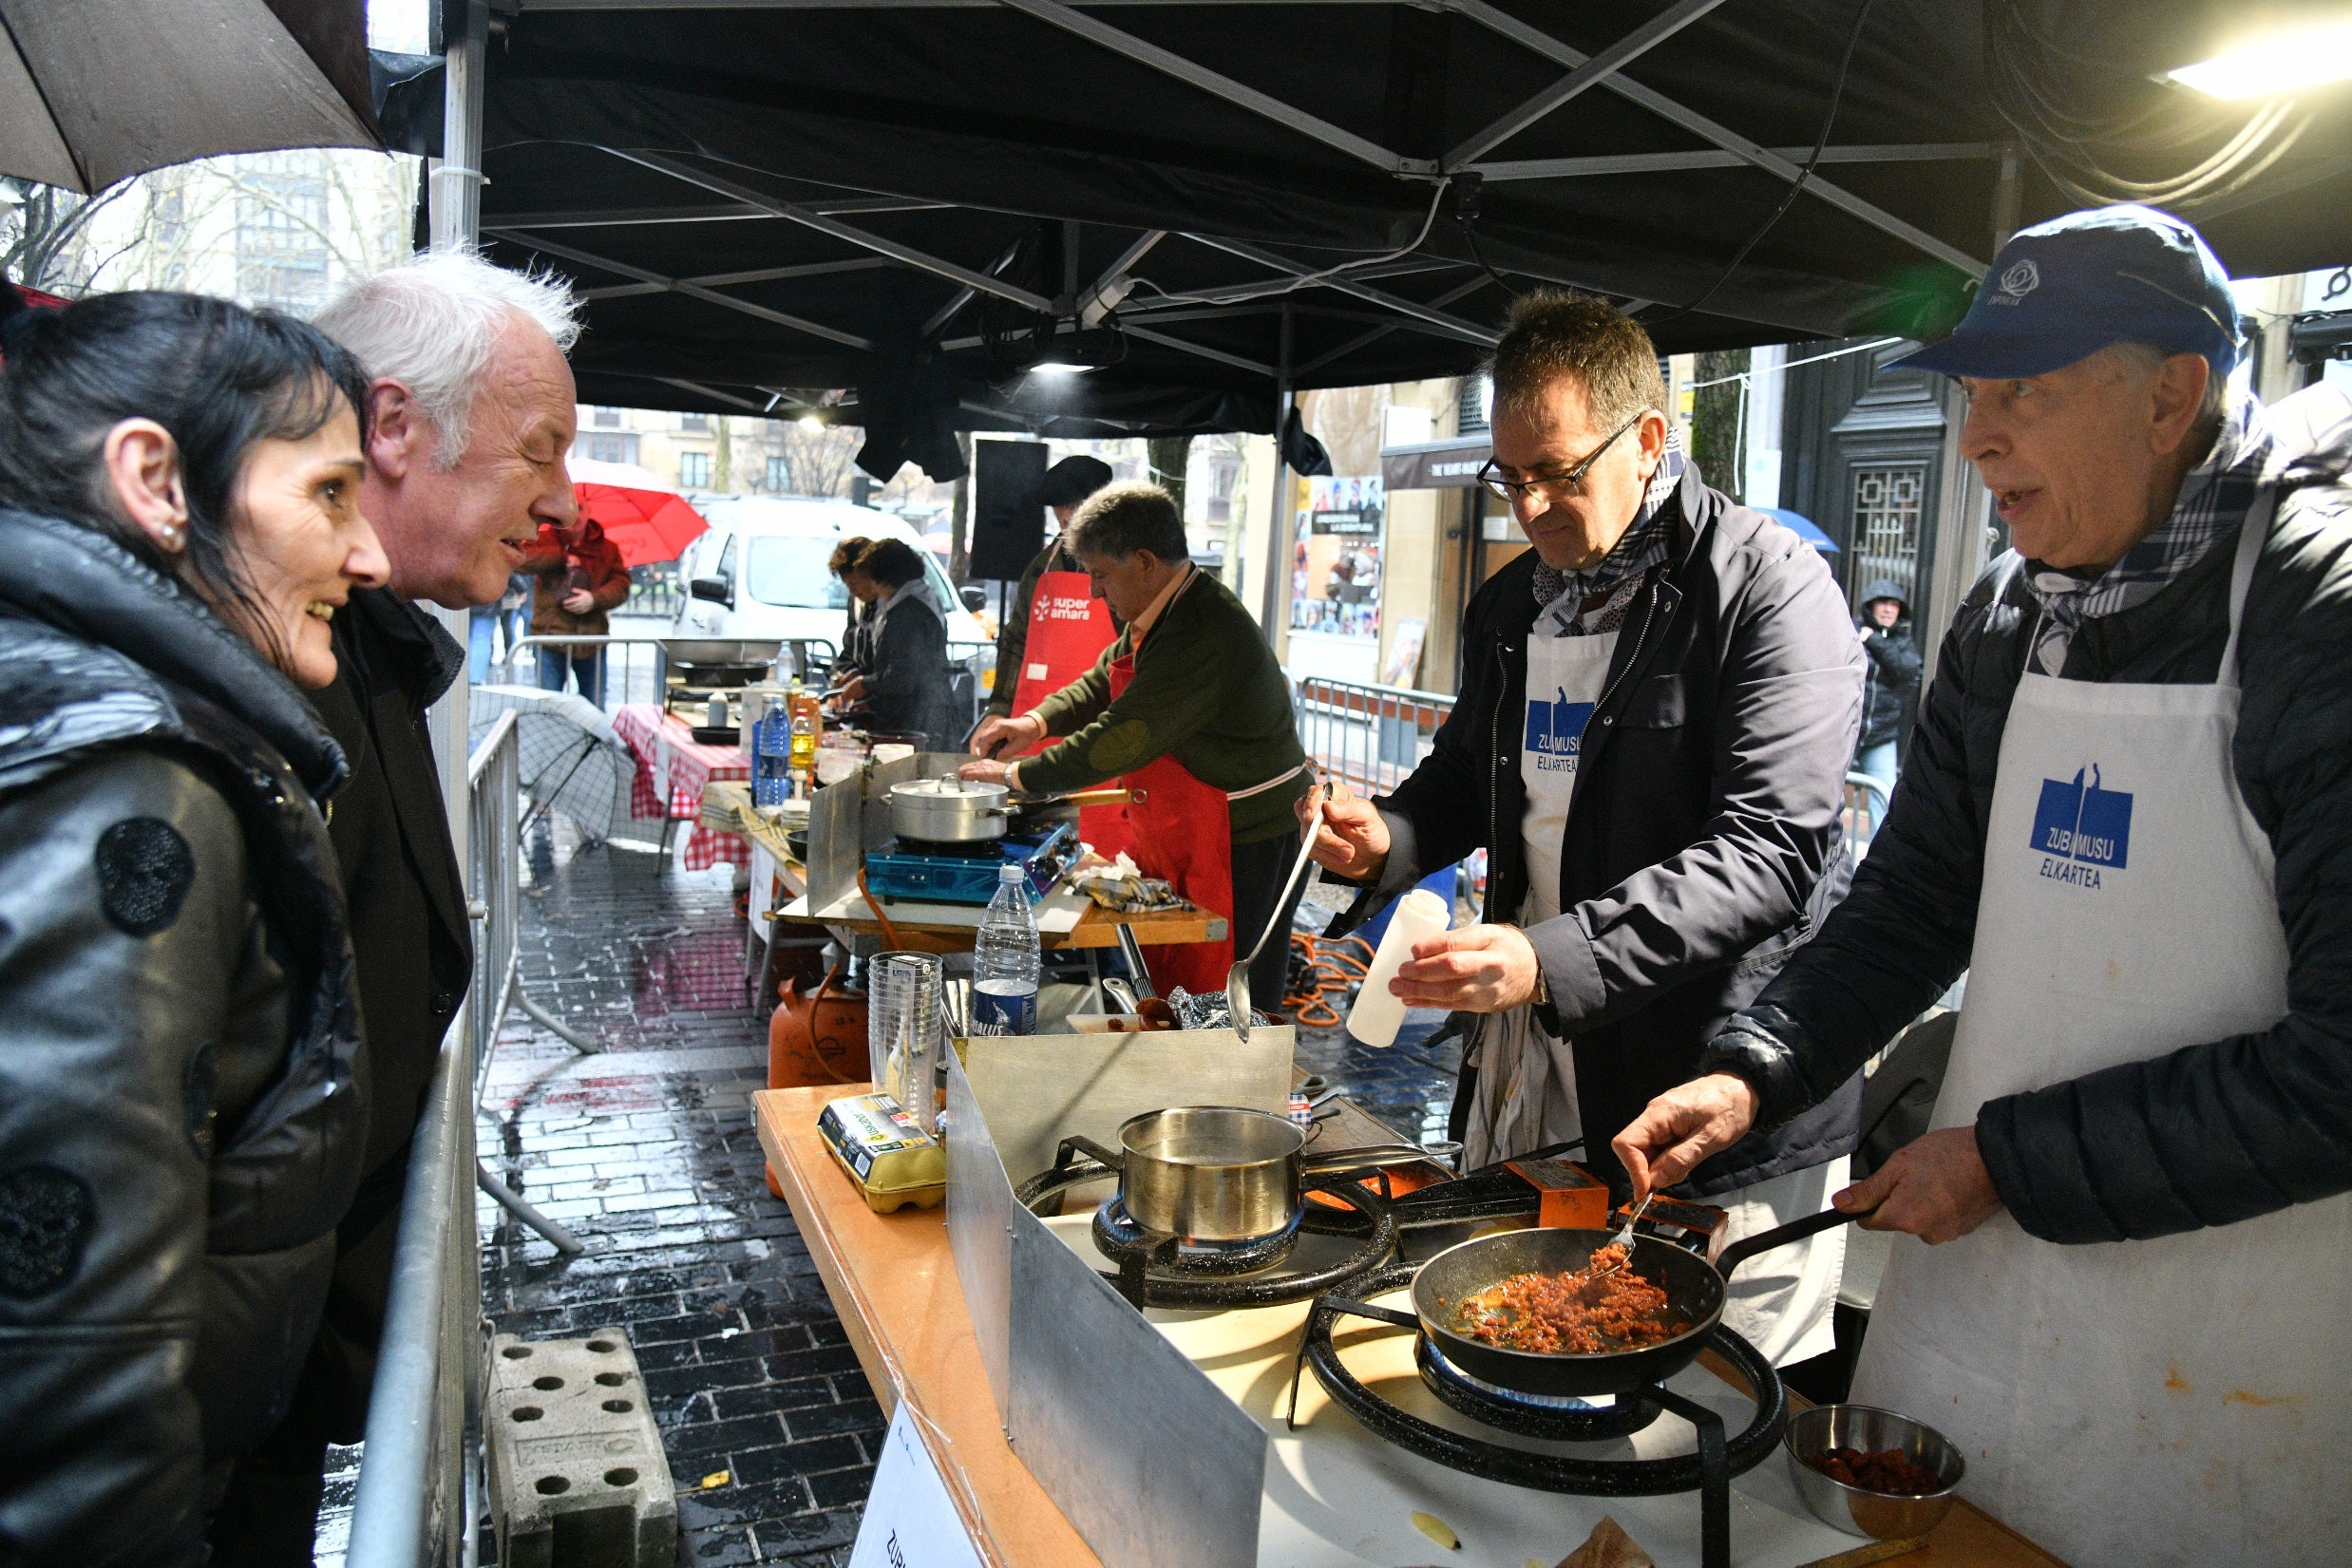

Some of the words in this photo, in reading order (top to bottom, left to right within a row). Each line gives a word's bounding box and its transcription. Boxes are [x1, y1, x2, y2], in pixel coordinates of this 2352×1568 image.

[1053, 597, 1091, 611] super
[1051, 609, 1091, 620] amara
[2039, 858, 2101, 890] ELKARTEA
